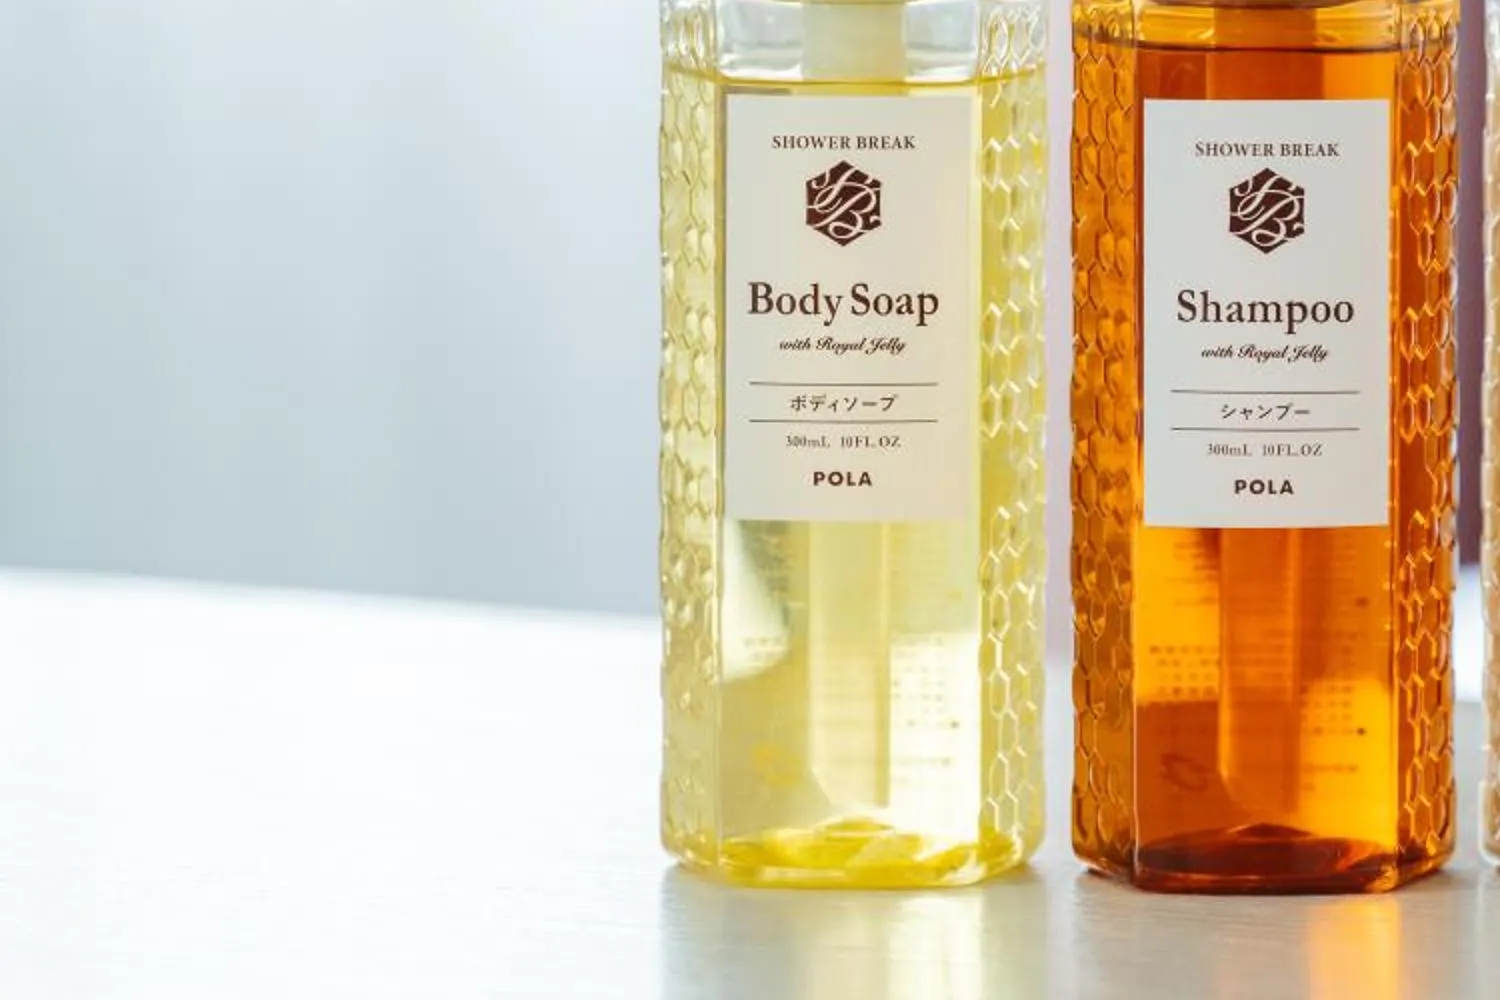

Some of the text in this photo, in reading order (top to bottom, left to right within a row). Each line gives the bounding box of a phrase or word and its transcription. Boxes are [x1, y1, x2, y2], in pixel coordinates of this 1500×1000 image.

[772, 135, 916, 150] SHOWER BREAK
[1194, 141, 1340, 158] SHOWER BREAK
[747, 281, 939, 327] Body Soap
[1176, 288, 1355, 335] Shampoo
[779, 337, 906, 355] with Royal Jelly
[1200, 344, 1328, 362] with Royal Jelly
[790, 394, 898, 412] ボディソープ
[1220, 402, 1310, 420] シャンプー
[785, 435, 830, 448] 300mL
[1207, 443, 1253, 456] 300mL
[812, 471, 872, 487] POLA
[1234, 480, 1294, 495] POLA
